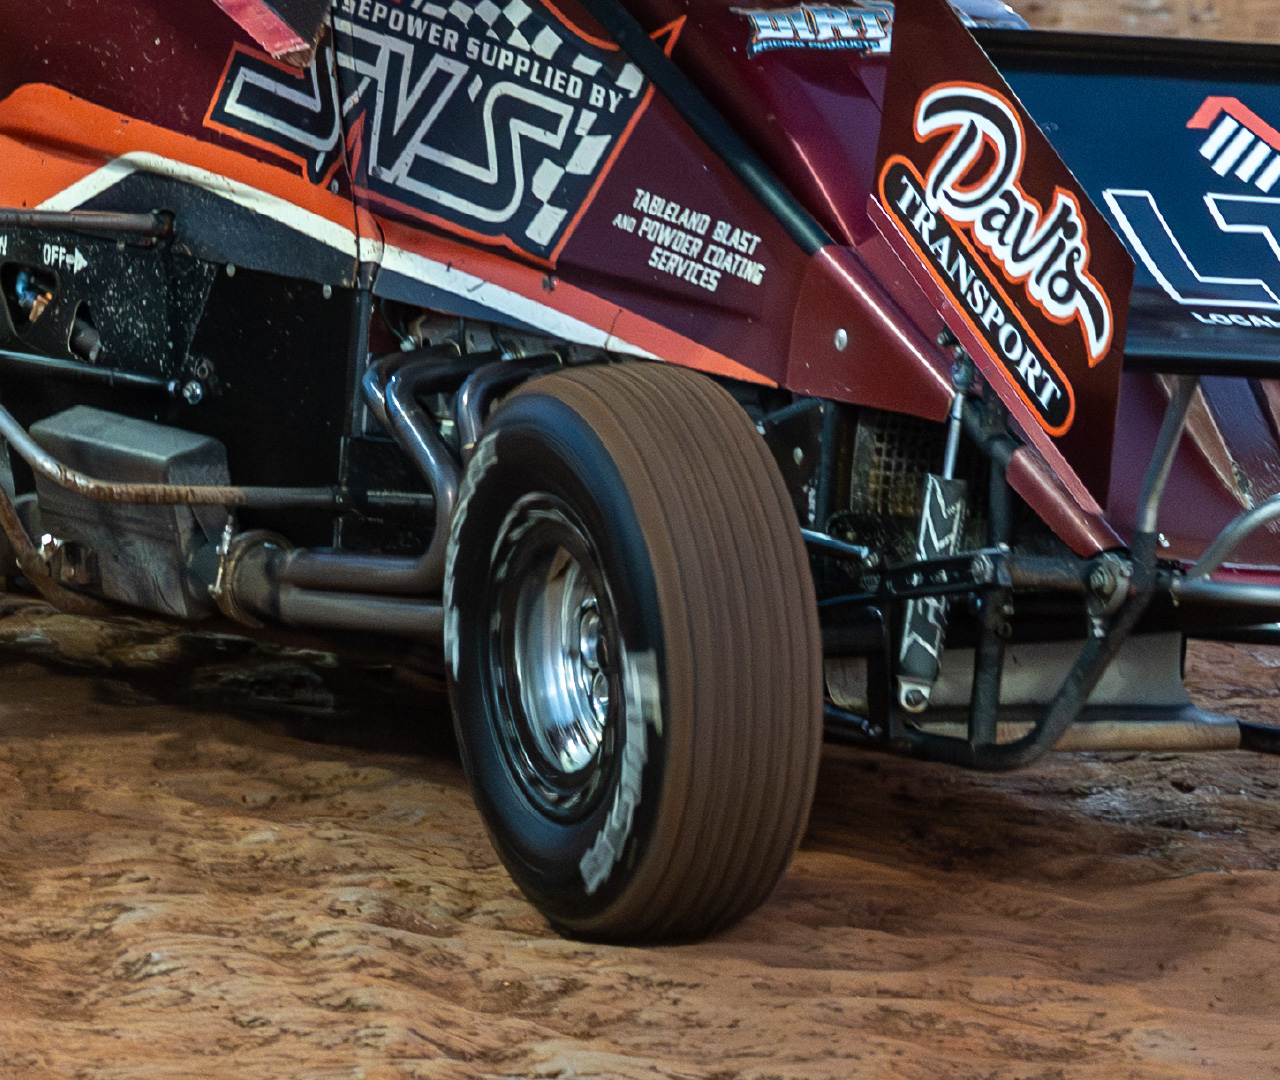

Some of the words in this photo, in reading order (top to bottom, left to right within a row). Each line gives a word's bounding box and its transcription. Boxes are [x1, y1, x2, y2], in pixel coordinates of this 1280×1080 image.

[465, 36, 583, 100] SUPPLIED
[588, 83, 624, 114] BY
[42, 244, 67, 269] OFF
[612, 213, 637, 233] AND
[638, 216, 704, 259] POWDER
[702, 243, 767, 286] COATING
[632, 187, 712, 236] TABLELAND
[711, 220, 762, 256] BLAST
[916, 83, 1112, 362] Davis
[648, 245, 722, 293] SERVICES
[894, 174, 1062, 412] TRANSPORT
